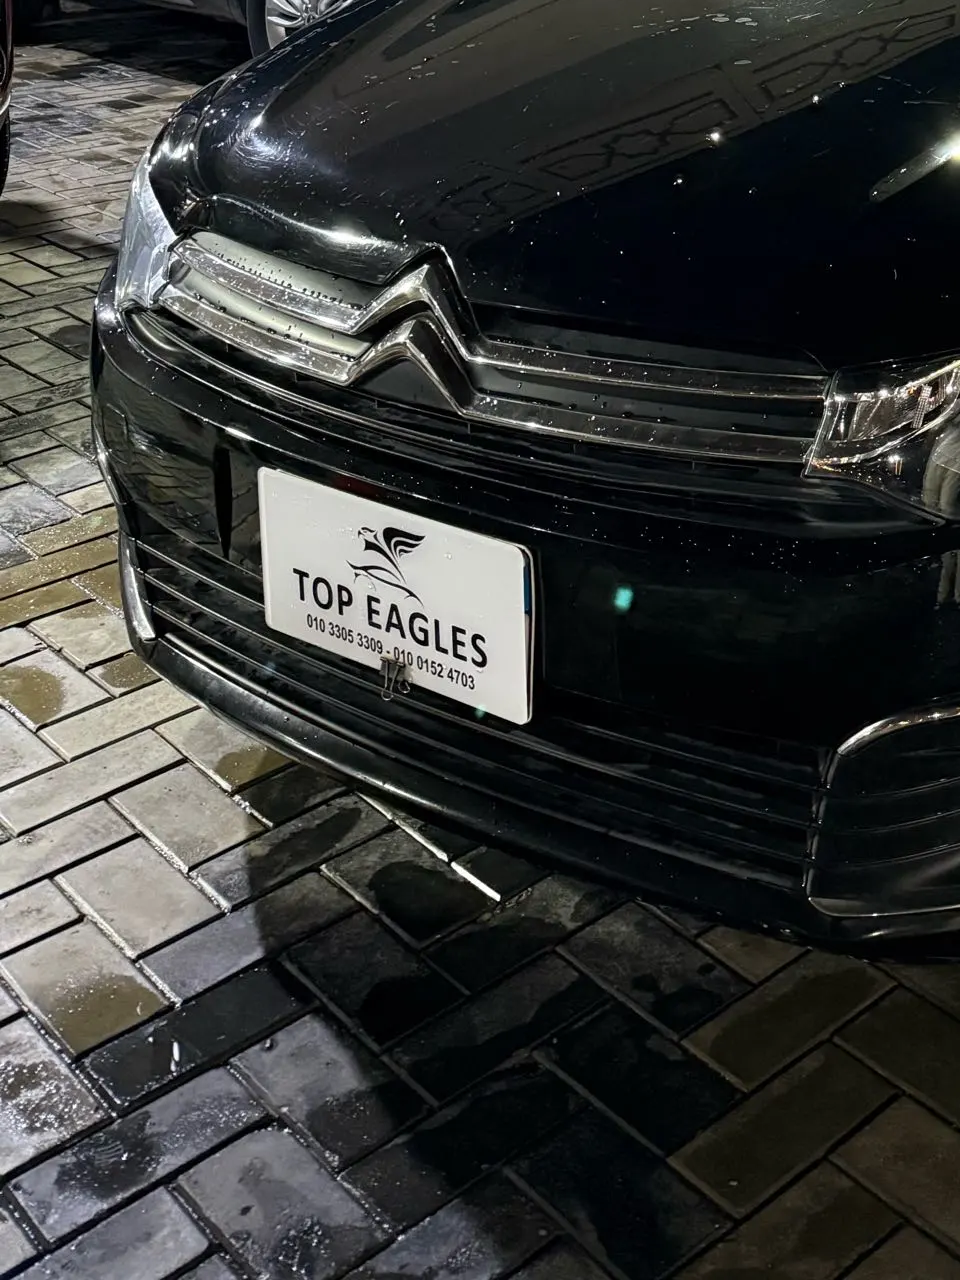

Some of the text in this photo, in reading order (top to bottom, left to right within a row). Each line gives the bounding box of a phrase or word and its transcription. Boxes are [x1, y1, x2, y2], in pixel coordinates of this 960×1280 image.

[293, 567, 488, 669] TOP EAGLES
[306, 613, 326, 633] 010
[328, 621, 354, 644] 3305
[356, 632, 383, 655] 3309
[393, 646, 413, 667] 010
[416, 655, 444, 679] 0152
[447, 667, 476, 691] 4703
